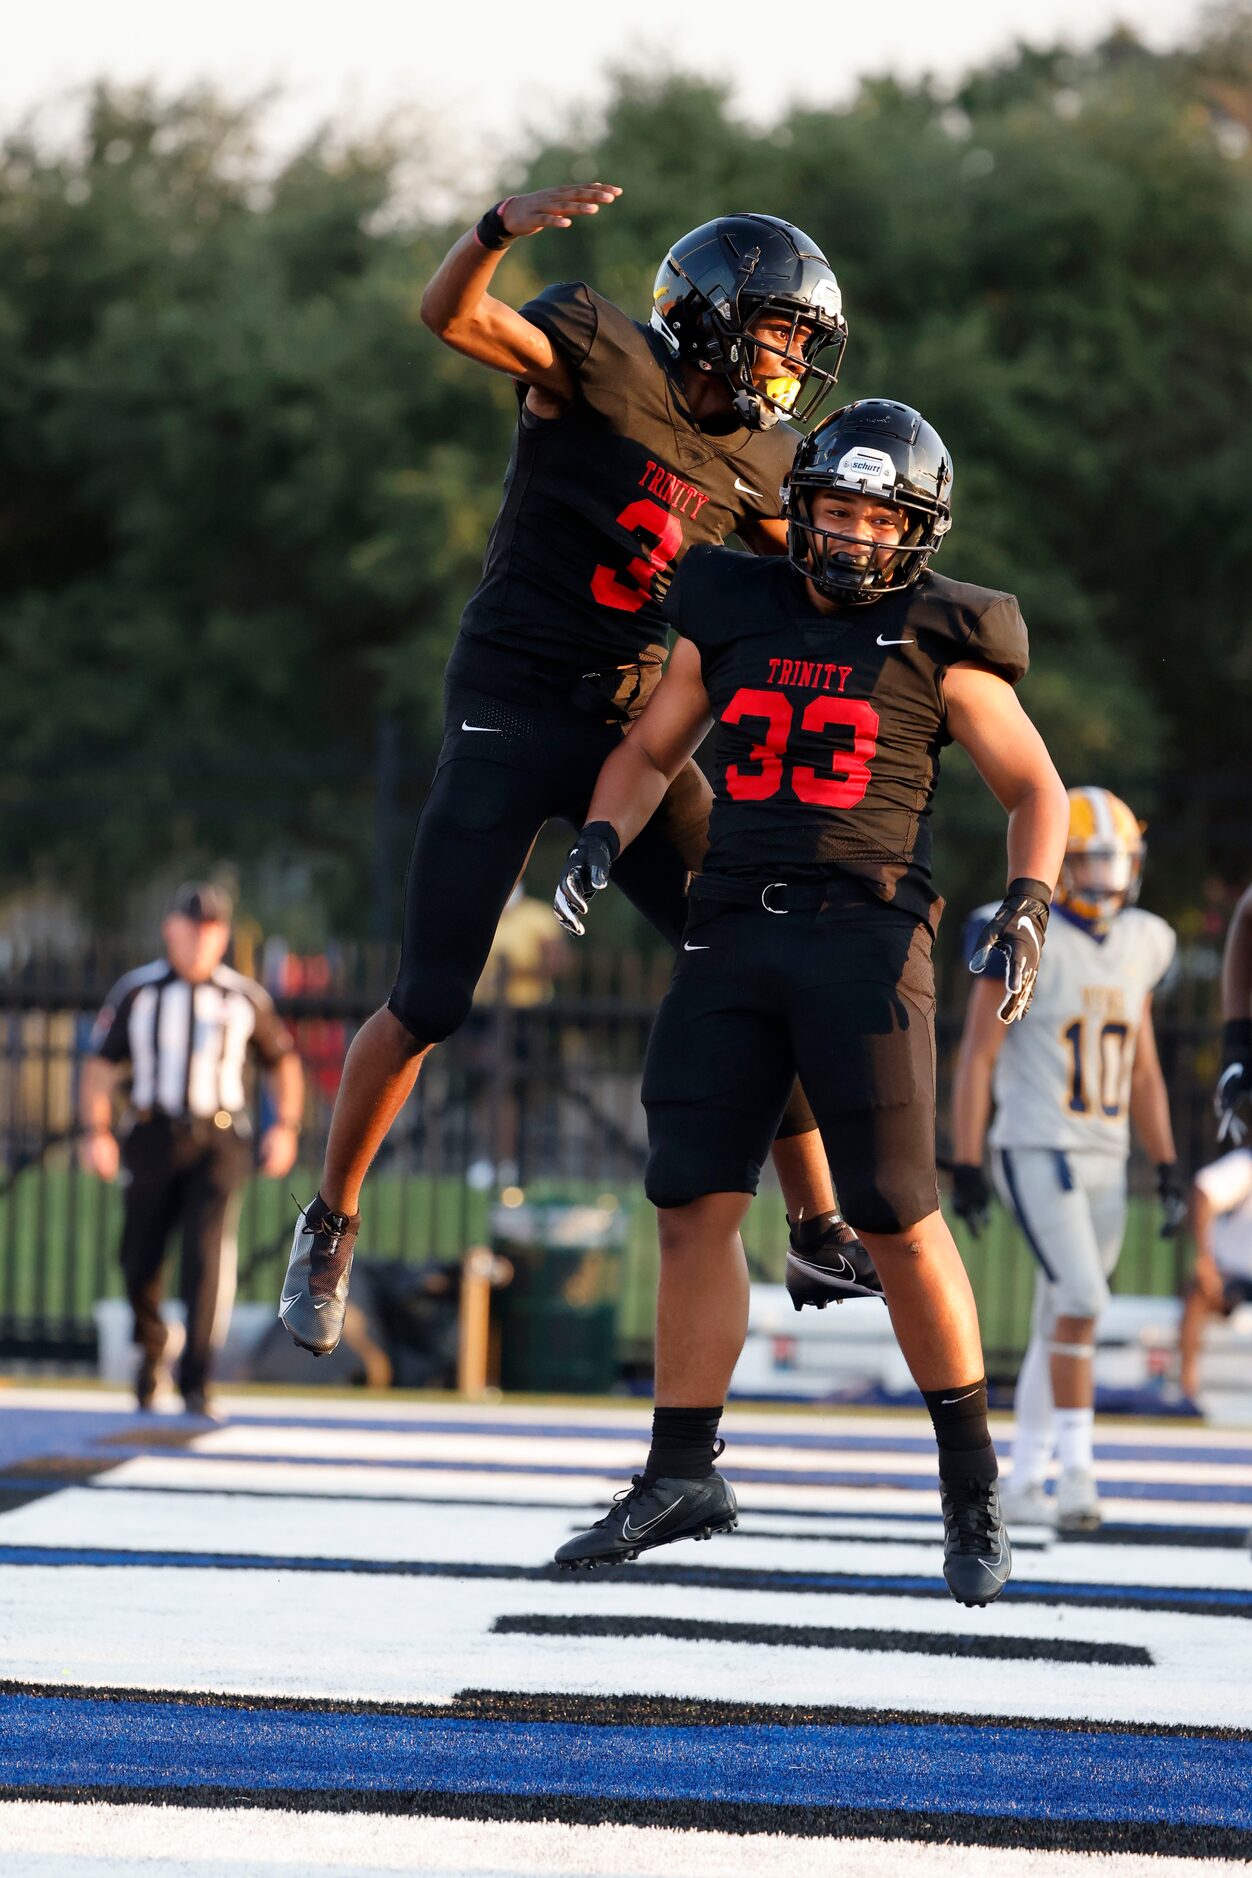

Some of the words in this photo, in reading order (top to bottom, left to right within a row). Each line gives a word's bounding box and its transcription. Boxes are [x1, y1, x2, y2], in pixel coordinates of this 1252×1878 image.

[638, 460, 710, 520] TRINITY
[852, 461, 881, 473] schutt
[590, 498, 684, 613] 3
[767, 657, 853, 693] TRINITY
[720, 687, 881, 810] 33
[1060, 1016, 1134, 1120] 10
